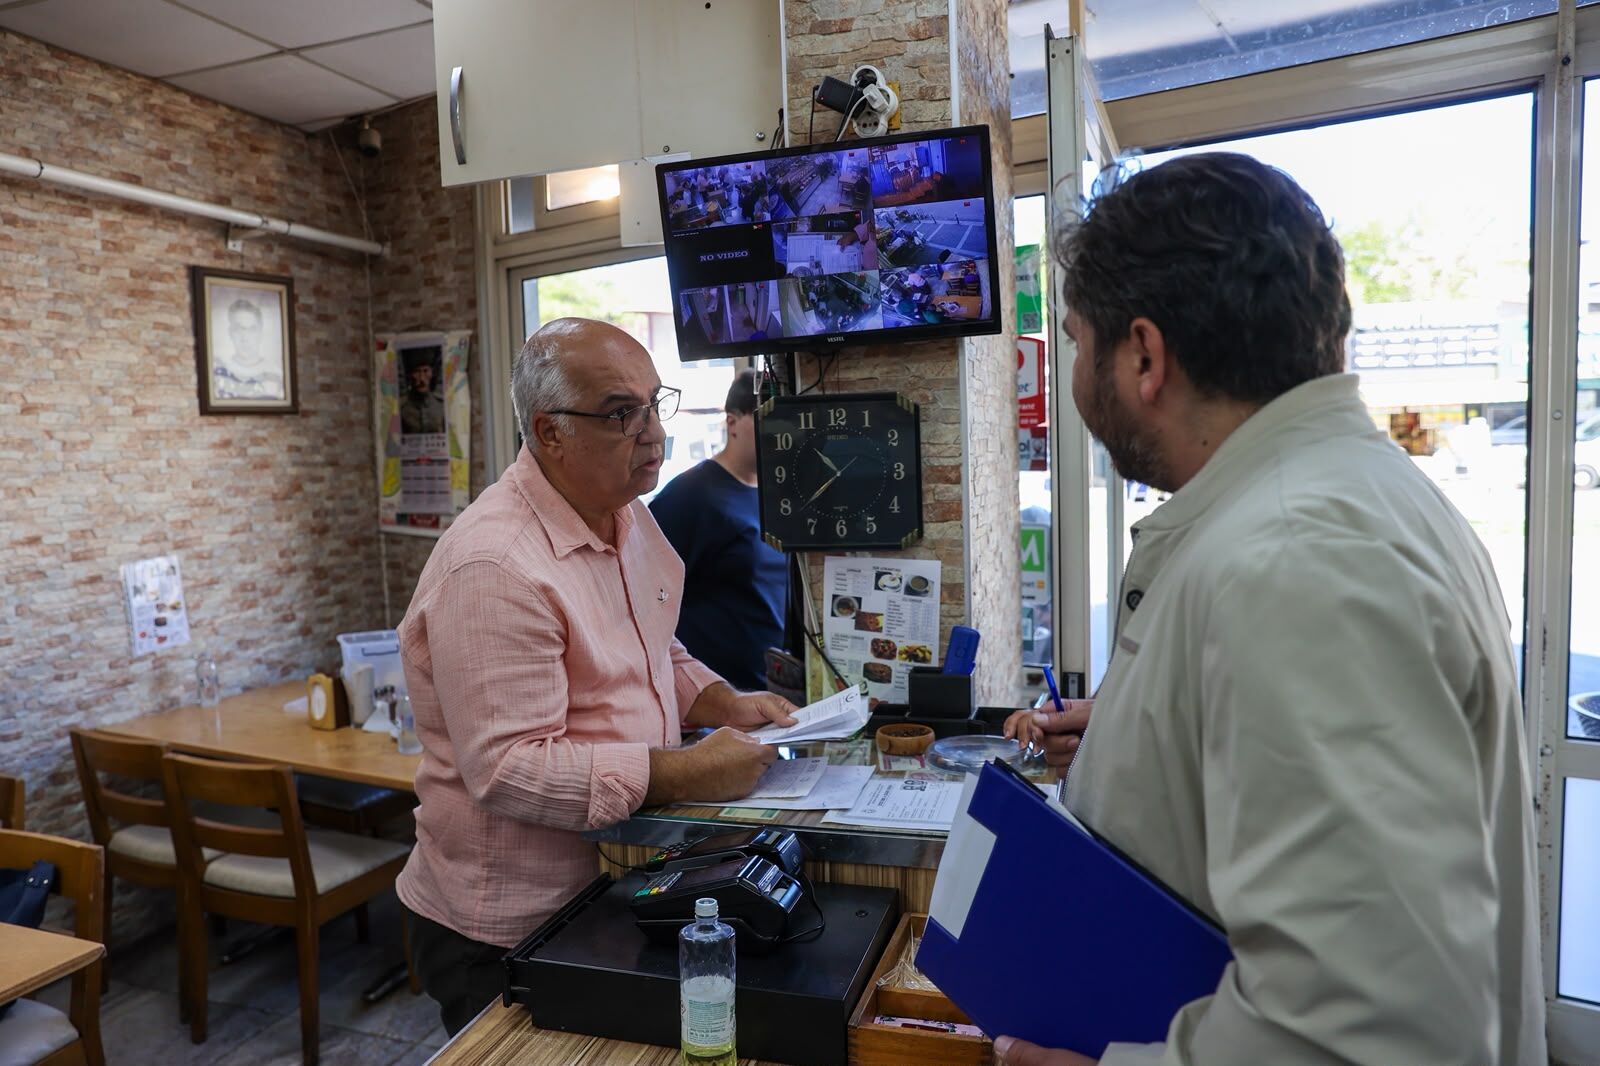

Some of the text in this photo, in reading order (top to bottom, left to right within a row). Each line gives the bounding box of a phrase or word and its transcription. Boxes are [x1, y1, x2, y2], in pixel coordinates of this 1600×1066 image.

[717, 250, 748, 260] VIDEO
[827, 335, 845, 343] VESTEL
[798, 412, 816, 430] 11
[827, 408, 847, 426] 12
[862, 410, 871, 428] 1
[774, 432, 793, 451] 10
[887, 429, 899, 447] 2
[775, 466, 786, 483] 9
[893, 462, 905, 480] 3
[780, 498, 792, 516] 8
[888, 495, 900, 513] 4
[807, 518, 818, 535] 7
[835, 519, 848, 537] 6
[866, 516, 877, 534] 5
